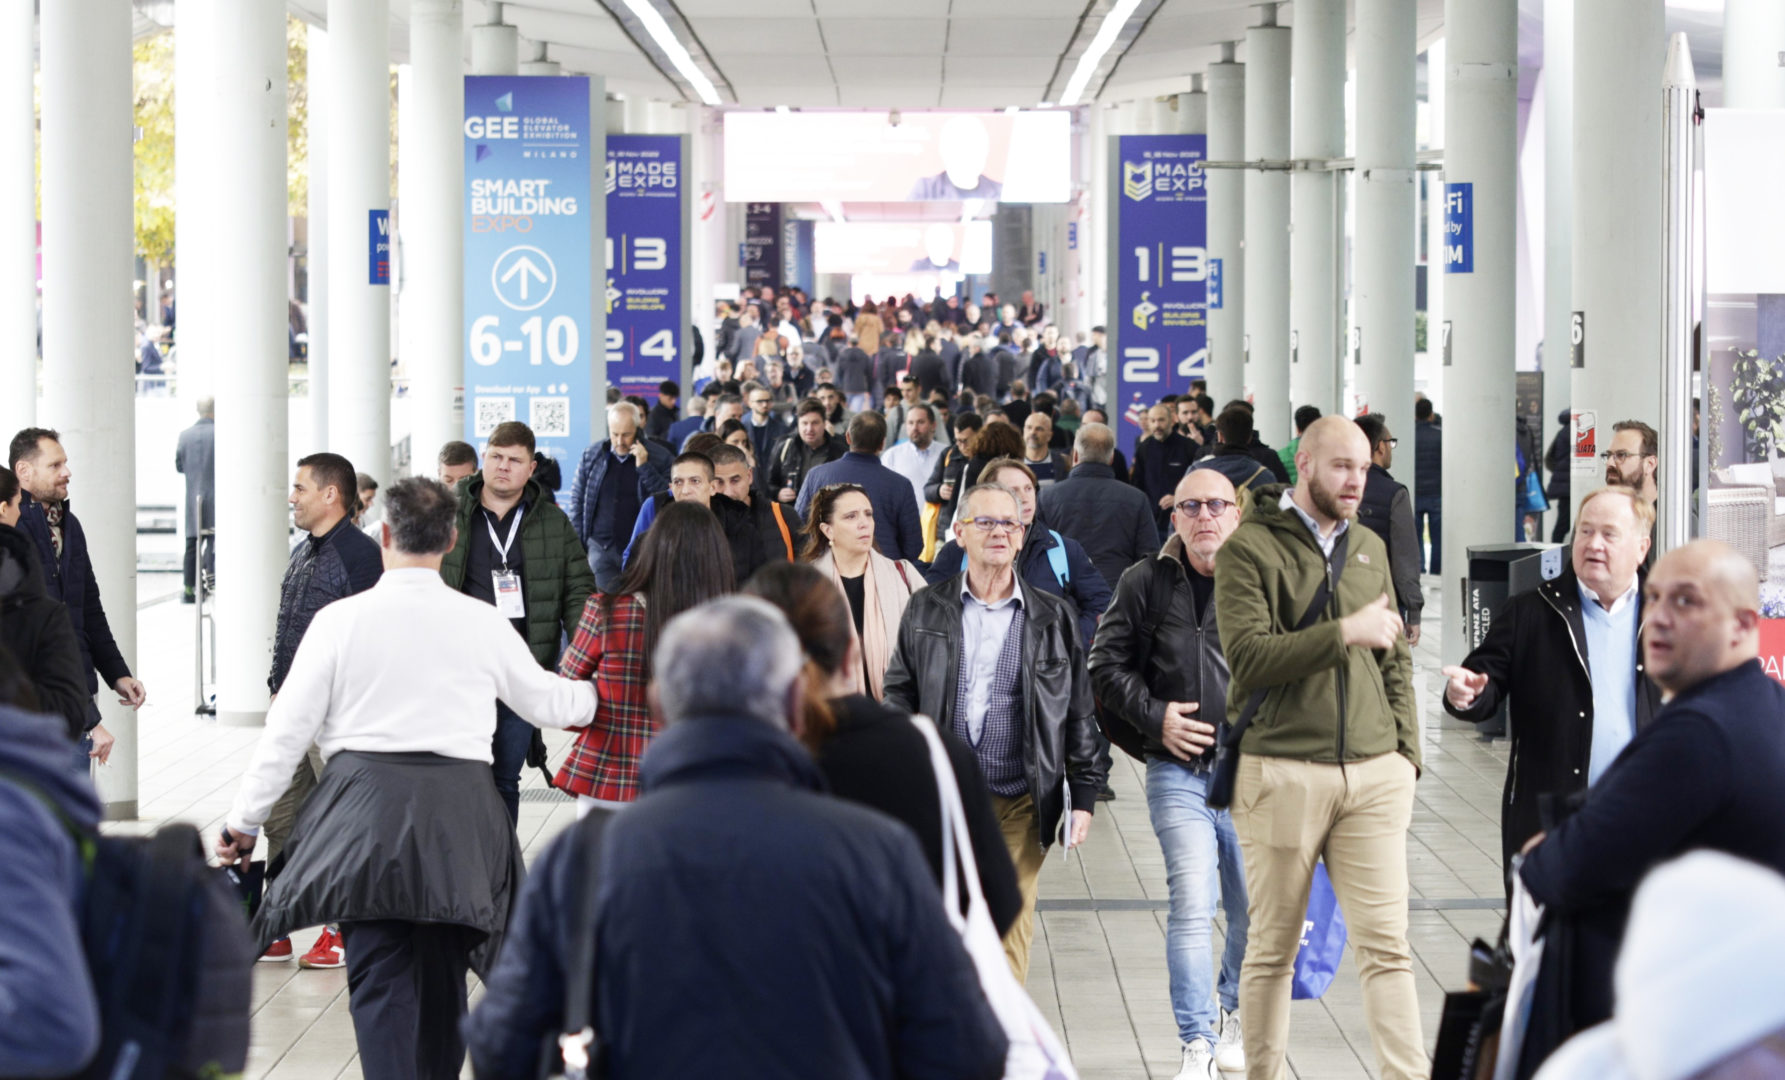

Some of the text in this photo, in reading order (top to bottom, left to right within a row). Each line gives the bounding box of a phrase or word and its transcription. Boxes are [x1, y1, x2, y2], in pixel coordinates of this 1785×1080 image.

[464, 116, 519, 139] GEE
[523, 117, 559, 125] GLOBAL
[523, 151, 577, 159] MILANO
[618, 162, 677, 175] MADE
[1155, 163, 1207, 177] MAD
[471, 179, 549, 197] SMART
[618, 175, 677, 188] EXPO
[1155, 178, 1207, 191] EXP
[471, 197, 578, 216] BUILDING
[472, 215, 533, 233] EXPO
[1451, 221, 1463, 236] by
[633, 237, 667, 270] 3
[1134, 247, 1207, 282] 1 3
[1571, 314, 1583, 345] 6
[469, 314, 579, 366] 6-10
[640, 329, 677, 362] 4
[1123, 347, 1208, 382] 2 4
